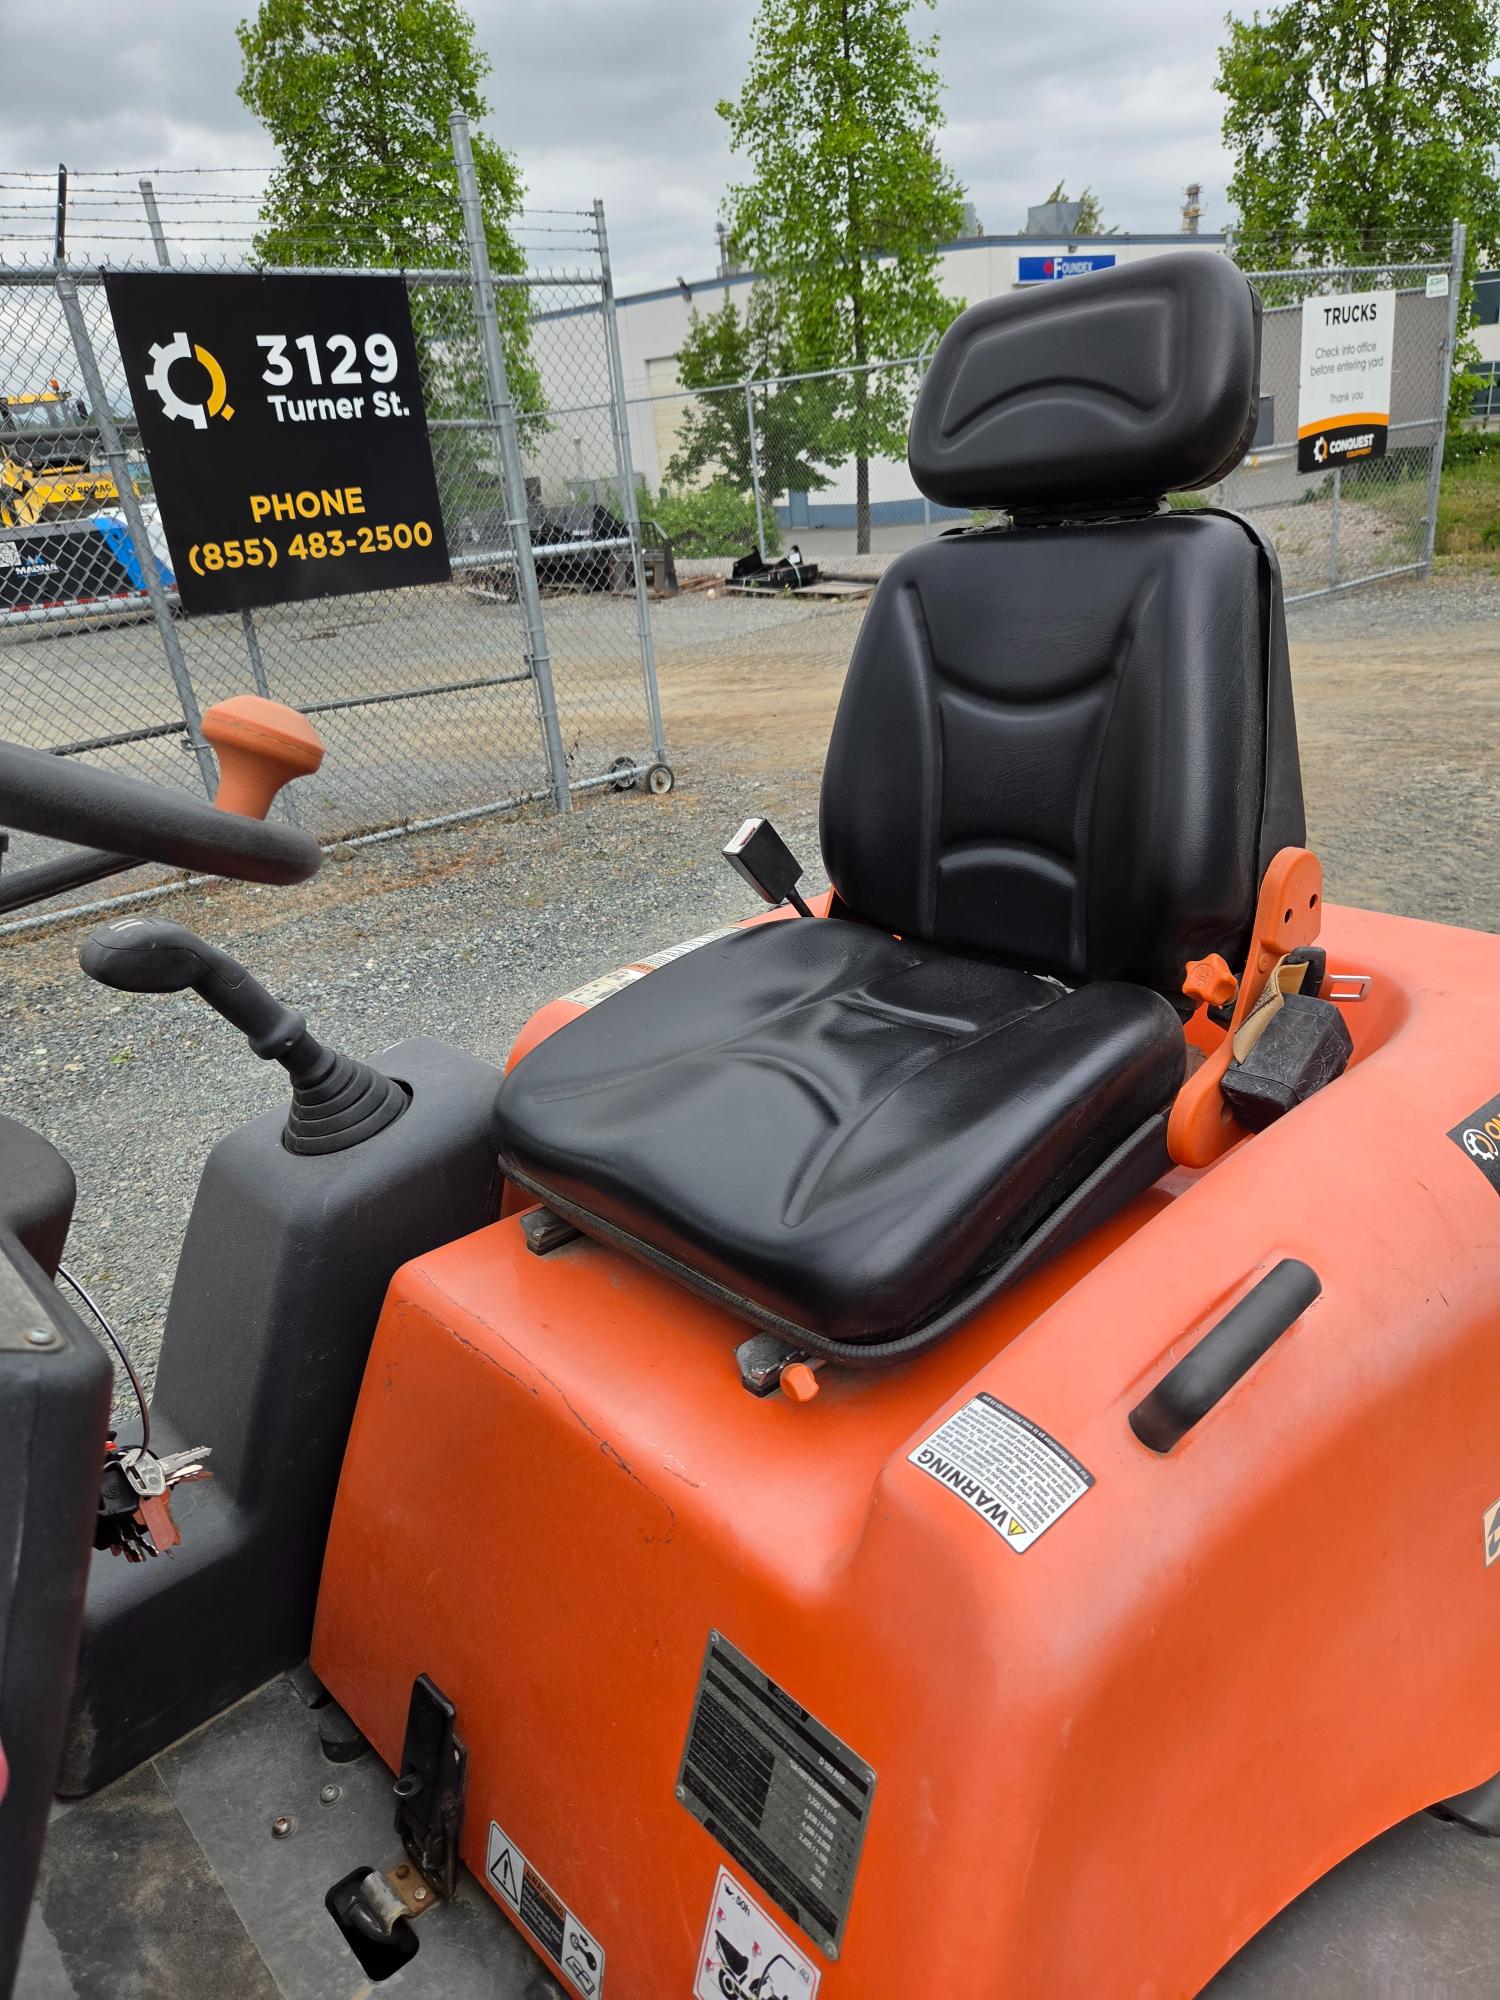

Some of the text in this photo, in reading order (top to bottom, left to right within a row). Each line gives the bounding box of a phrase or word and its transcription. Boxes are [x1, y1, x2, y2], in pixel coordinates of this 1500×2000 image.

[1054, 258, 1094, 280] FOUNDEX
[1324, 304, 1377, 326] TRUCKS
[256, 333, 398, 386] 3129
[1315, 342, 1377, 360] Check into office
[1310, 356, 1384, 376] before entering yard
[267, 391, 410, 422] Turner St.
[1350, 391, 1364, 402] you
[1330, 433, 1374, 454] CONQUEST
[250, 487, 366, 523] PHONE
[189, 521, 433, 576] (855) 483-2500
[915, 1447, 1008, 1527] WARNING
[736, 1896, 752, 1916] 50h
